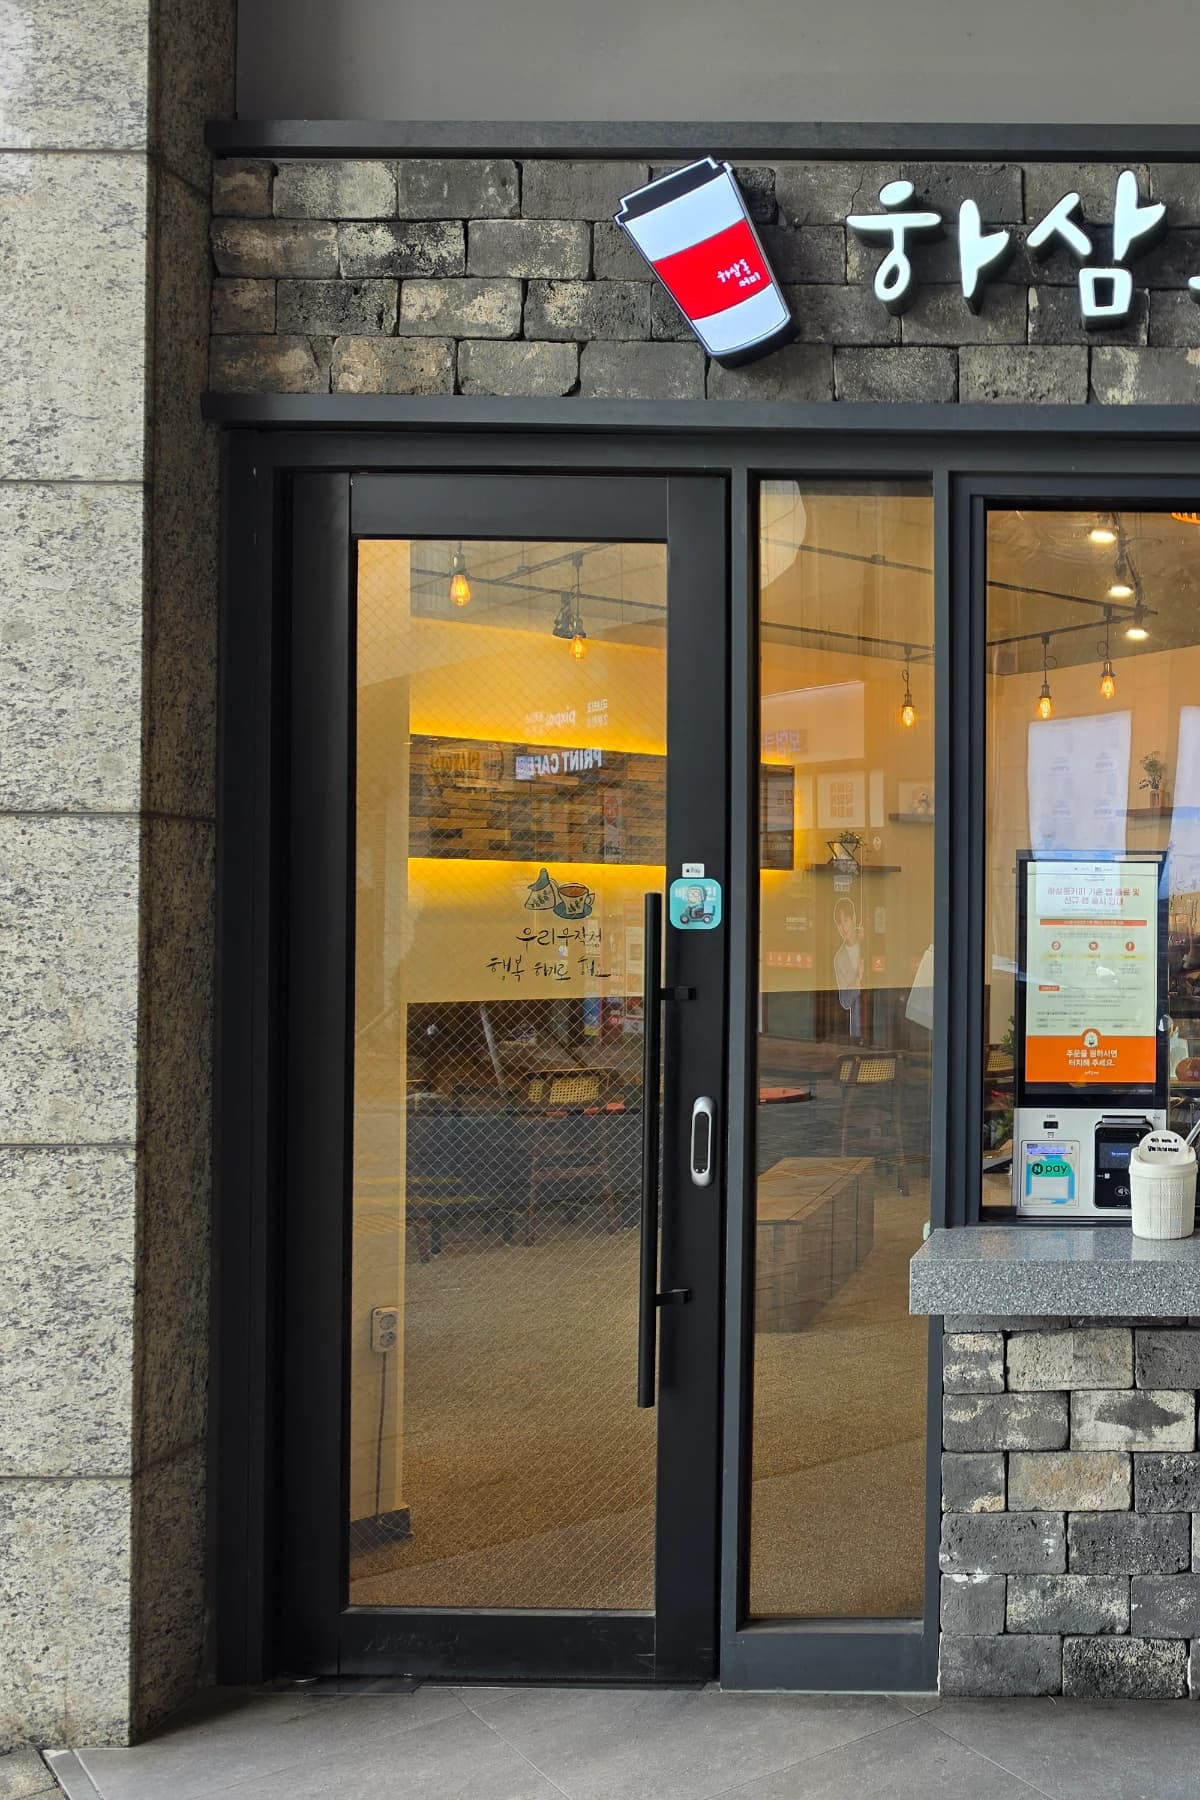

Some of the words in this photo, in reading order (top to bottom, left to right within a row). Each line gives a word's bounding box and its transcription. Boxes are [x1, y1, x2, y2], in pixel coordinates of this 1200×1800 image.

[717, 259, 751, 283] 하삼동
[739, 271, 761, 287] 커피
[1046, 1164, 1068, 1174] pay
